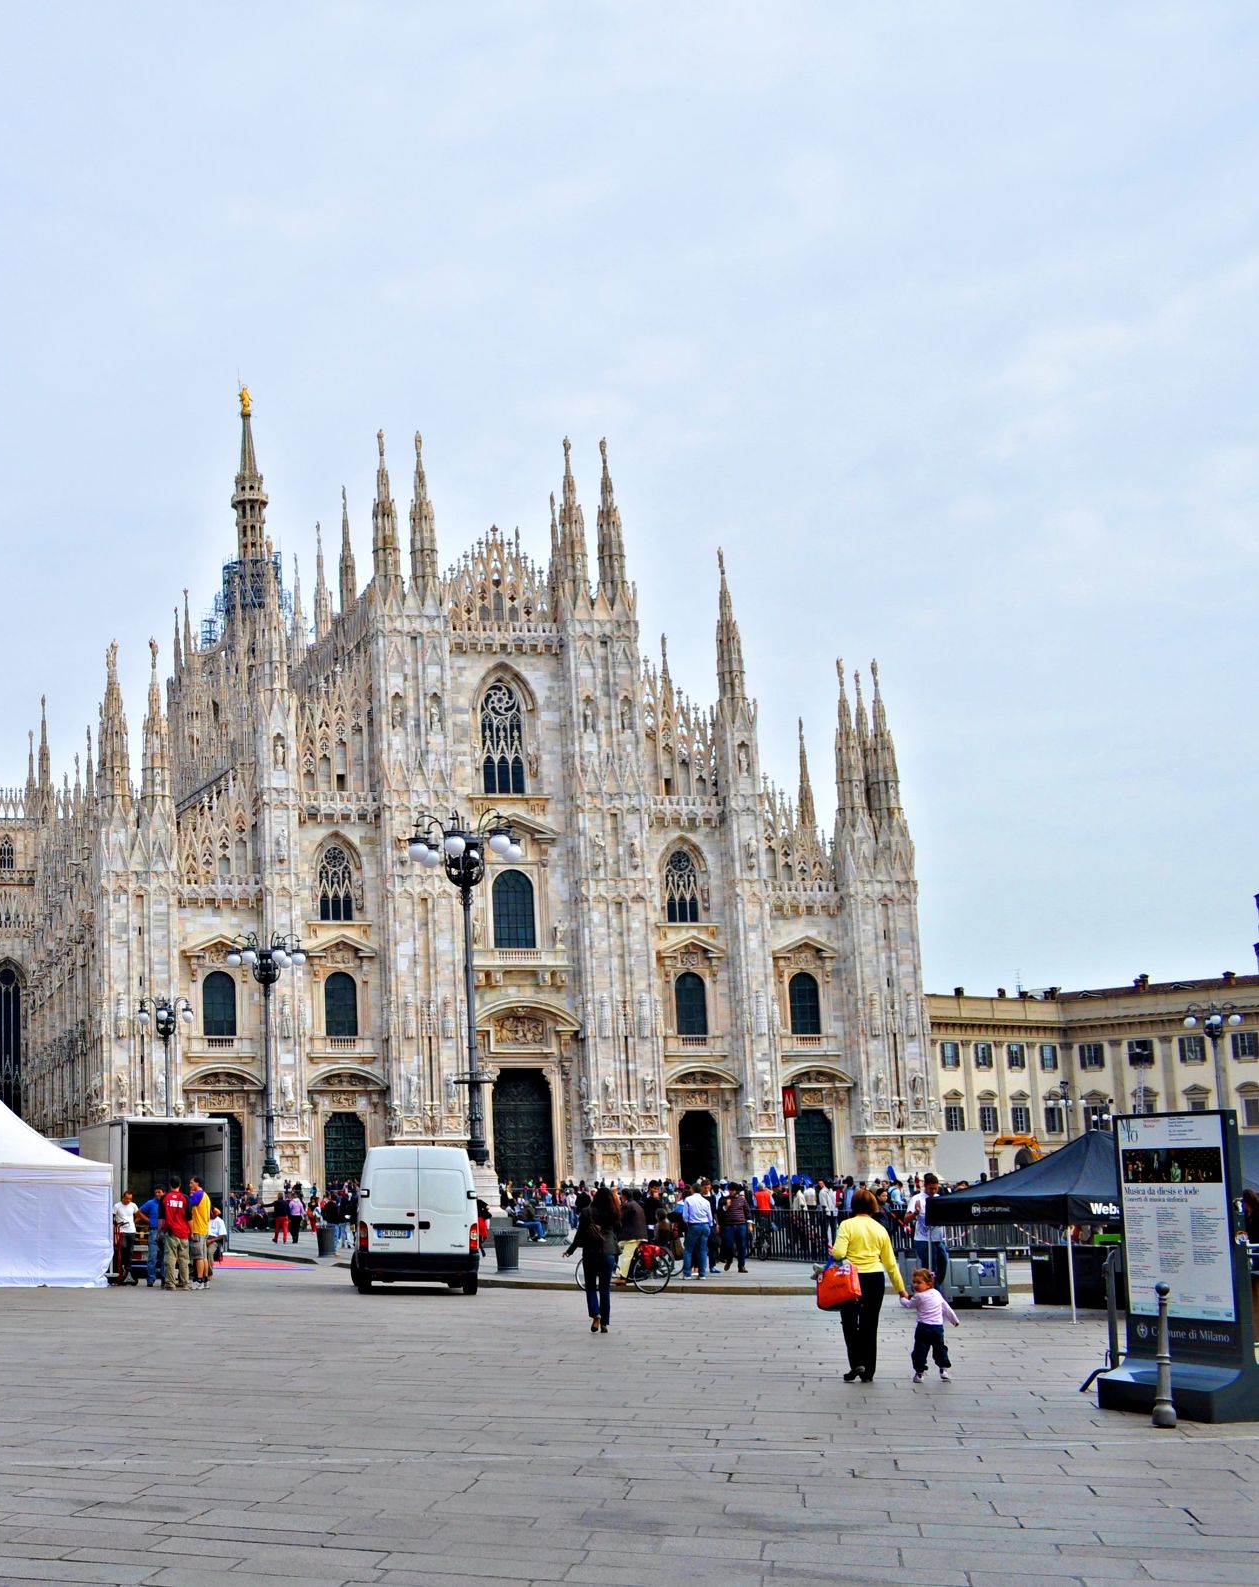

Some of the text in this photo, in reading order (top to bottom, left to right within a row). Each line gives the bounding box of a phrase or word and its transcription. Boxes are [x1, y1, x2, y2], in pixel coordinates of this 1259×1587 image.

[785, 1093, 796, 1111] M
[1124, 1186, 1146, 1196] Musica
[1147, 1186, 1156, 1196] da
[1157, 1186, 1177, 1196] diesis
[1184, 1186, 1200, 1196] lode
[1151, 1326, 1230, 1343] Cune di Milano
